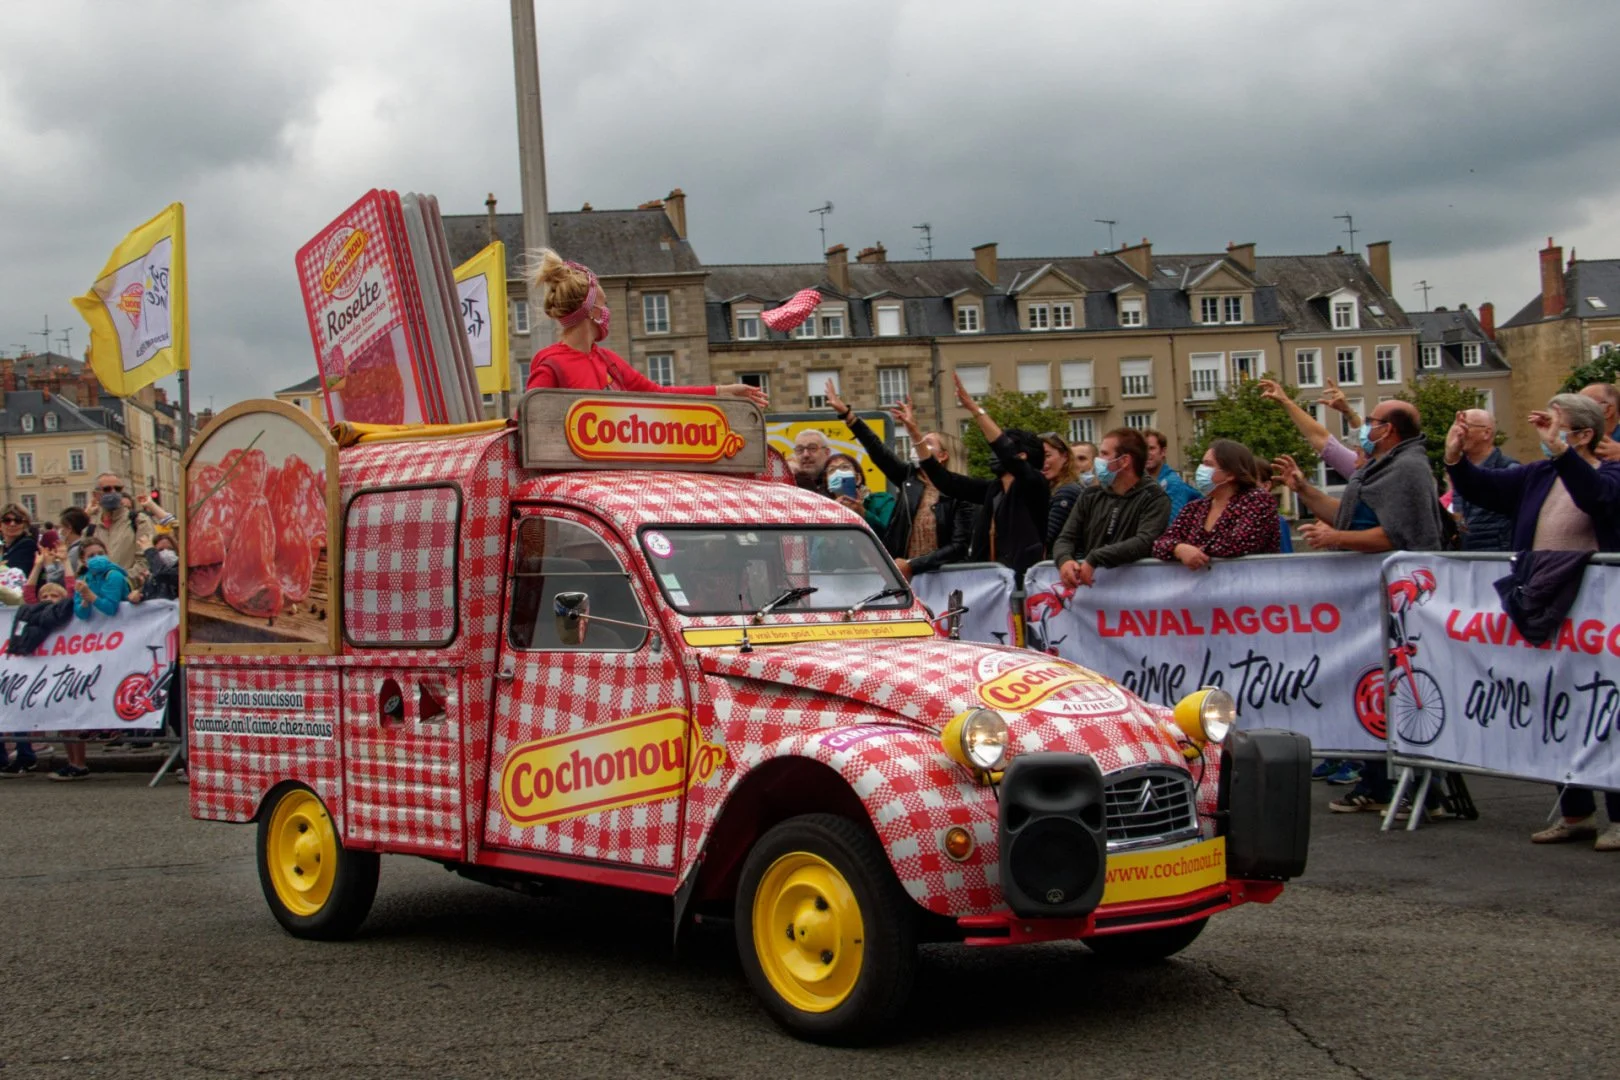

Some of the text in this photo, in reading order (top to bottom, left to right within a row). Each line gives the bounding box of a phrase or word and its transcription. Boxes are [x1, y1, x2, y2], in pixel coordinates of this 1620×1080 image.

[324, 237, 363, 290] Cochonou
[327, 281, 381, 341] Rosette
[577, 411, 718, 447] Cochonou
[1096, 602, 1342, 637] LAVAL AGGLO
[52, 631, 125, 656] AGGLO
[21, 664, 48, 711] le
[217, 688, 304, 708] Le bon saucisson
[1465, 667, 1533, 730] aime
[1542, 666, 1571, 744] le
[194, 716, 333, 738] comme on l'aime chez nous
[511, 736, 686, 808] Cochonou
[1105, 848, 1222, 884] www.cochonou.fr
